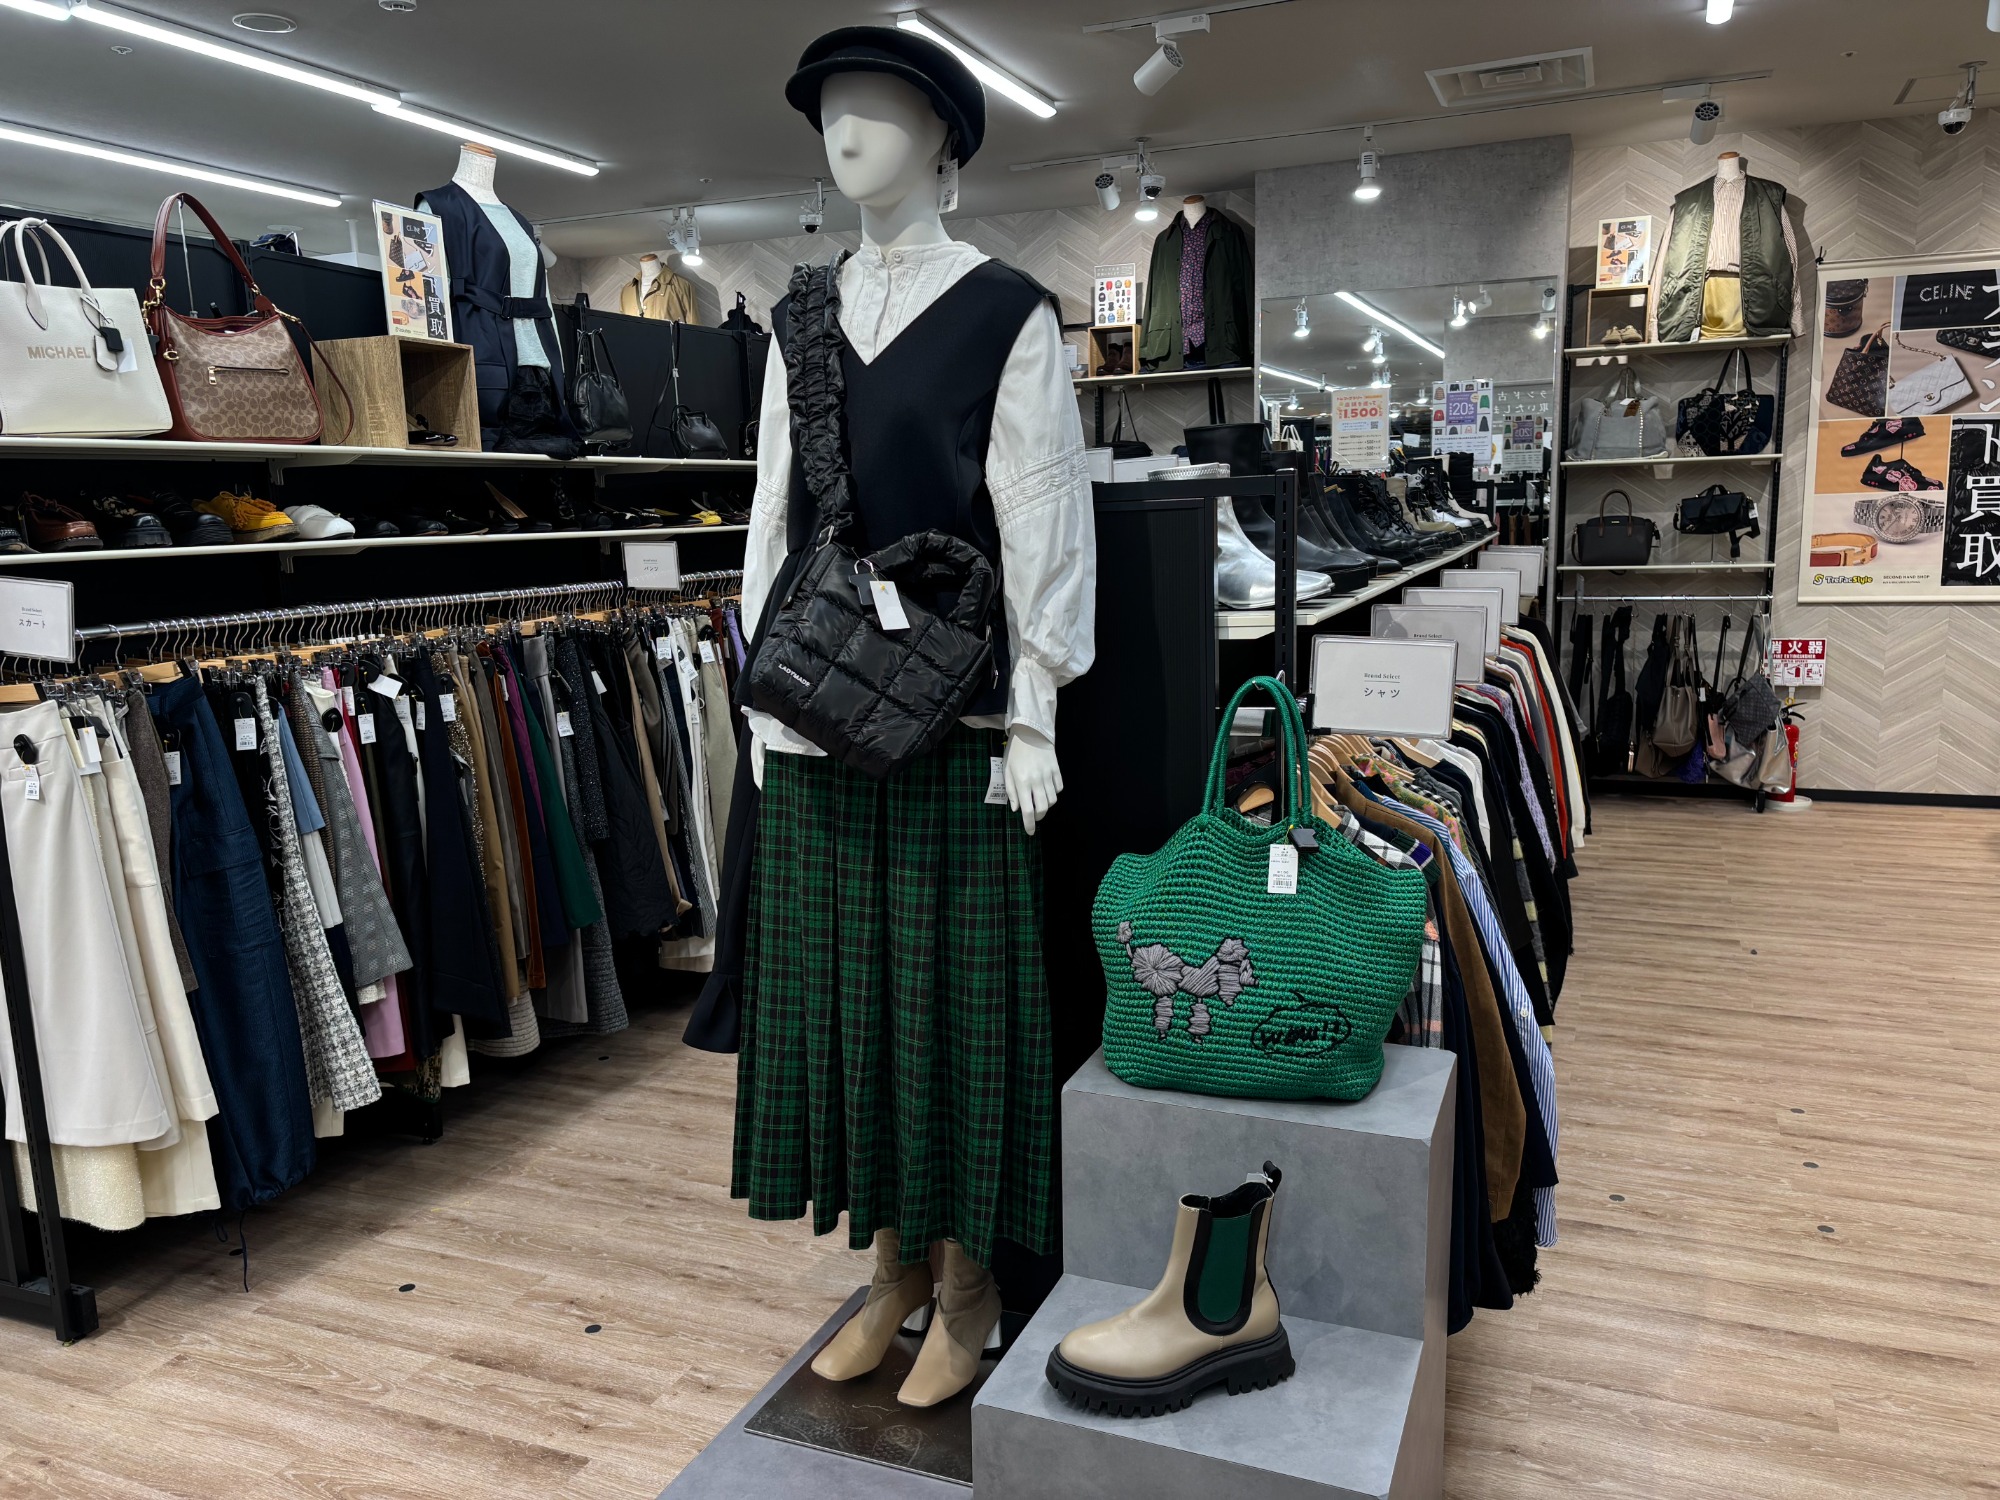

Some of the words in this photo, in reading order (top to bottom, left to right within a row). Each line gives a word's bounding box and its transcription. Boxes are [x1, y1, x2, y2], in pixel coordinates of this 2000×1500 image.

[1919, 283, 1975, 302] CELINE
[27, 346, 91, 359] MICHAEL
[19, 619, 46, 628] スカート
[1364, 687, 1400, 698] シャツ
